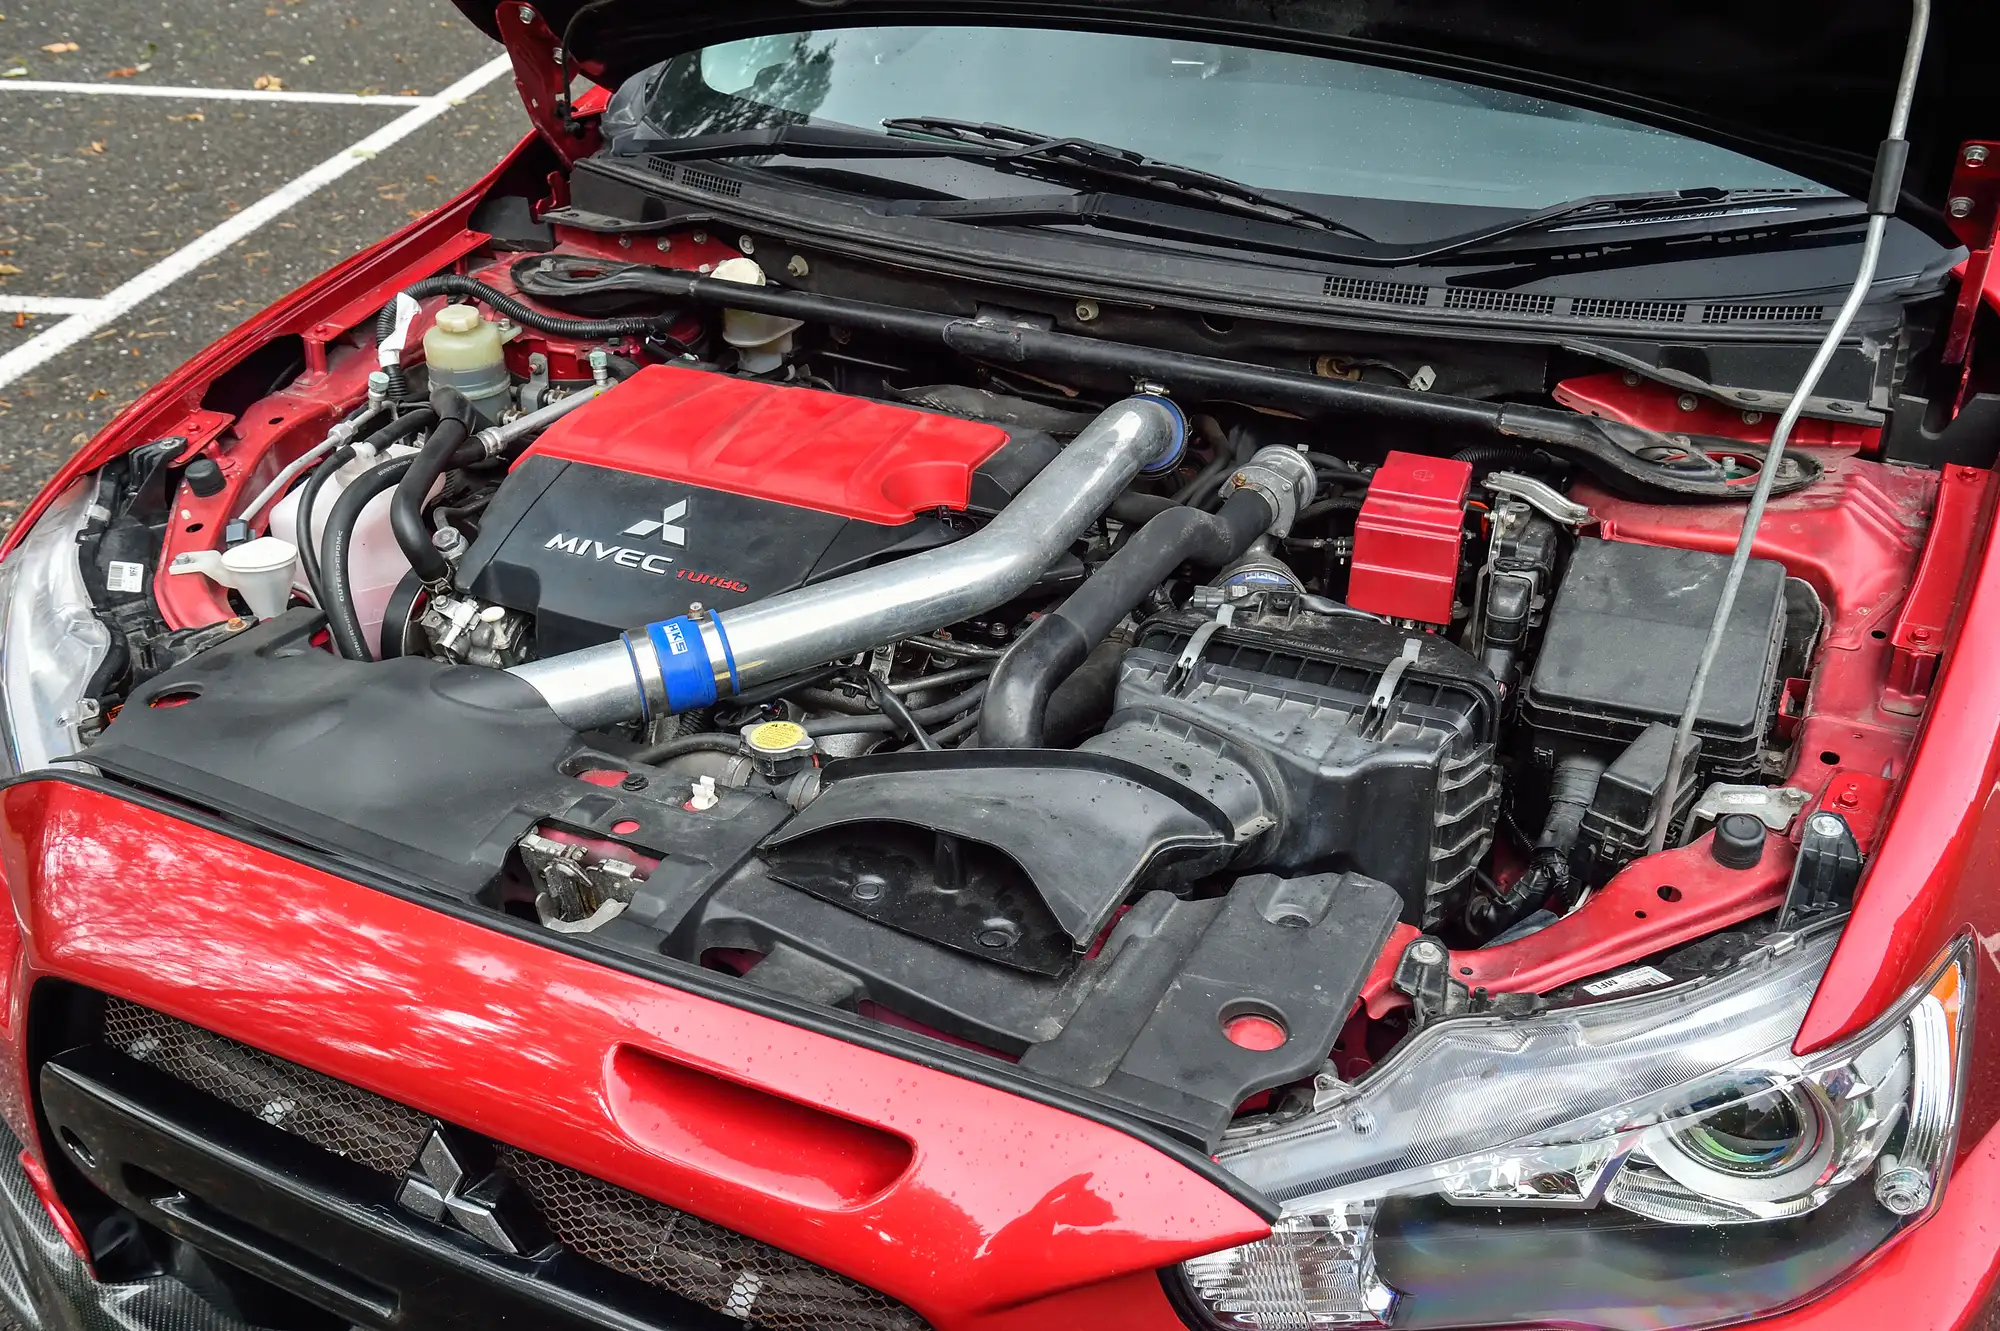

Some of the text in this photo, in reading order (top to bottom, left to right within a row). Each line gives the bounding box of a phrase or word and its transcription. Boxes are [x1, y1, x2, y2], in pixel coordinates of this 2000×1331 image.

[544, 533, 674, 575] MIVEC
[675, 568, 748, 593] TURBO
[667, 623, 687, 652] HKS
[1590, 978, 1619, 990] MFL
